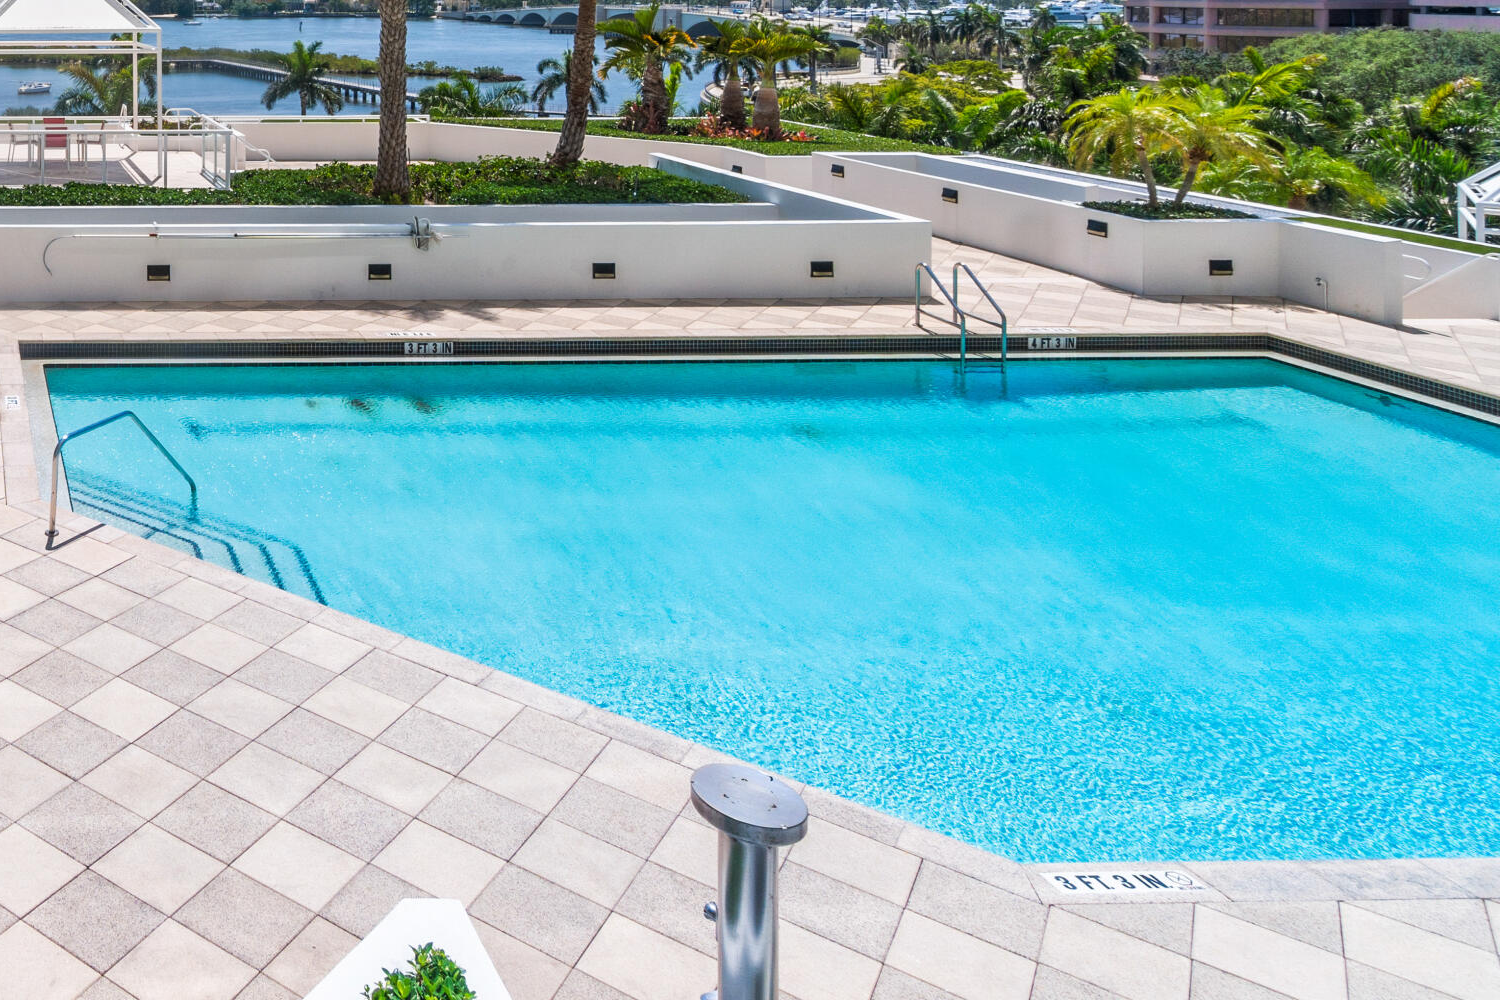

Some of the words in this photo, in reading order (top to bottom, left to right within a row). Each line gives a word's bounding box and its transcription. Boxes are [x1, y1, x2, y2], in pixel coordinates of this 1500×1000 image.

[408, 343, 414, 353] 3
[417, 343, 428, 353] FT
[432, 343, 438, 353] 3
[442, 343, 452, 353] IN
[1031, 338, 1037, 348] 4
[1041, 338, 1051, 348] FT
[1055, 338, 1061, 348] 3
[1065, 338, 1075, 348] IN
[1054, 875, 1077, 890] 3
[1076, 875, 1115, 890] FT.
[1113, 875, 1136, 889] 3
[1132, 874, 1173, 889] IN.
